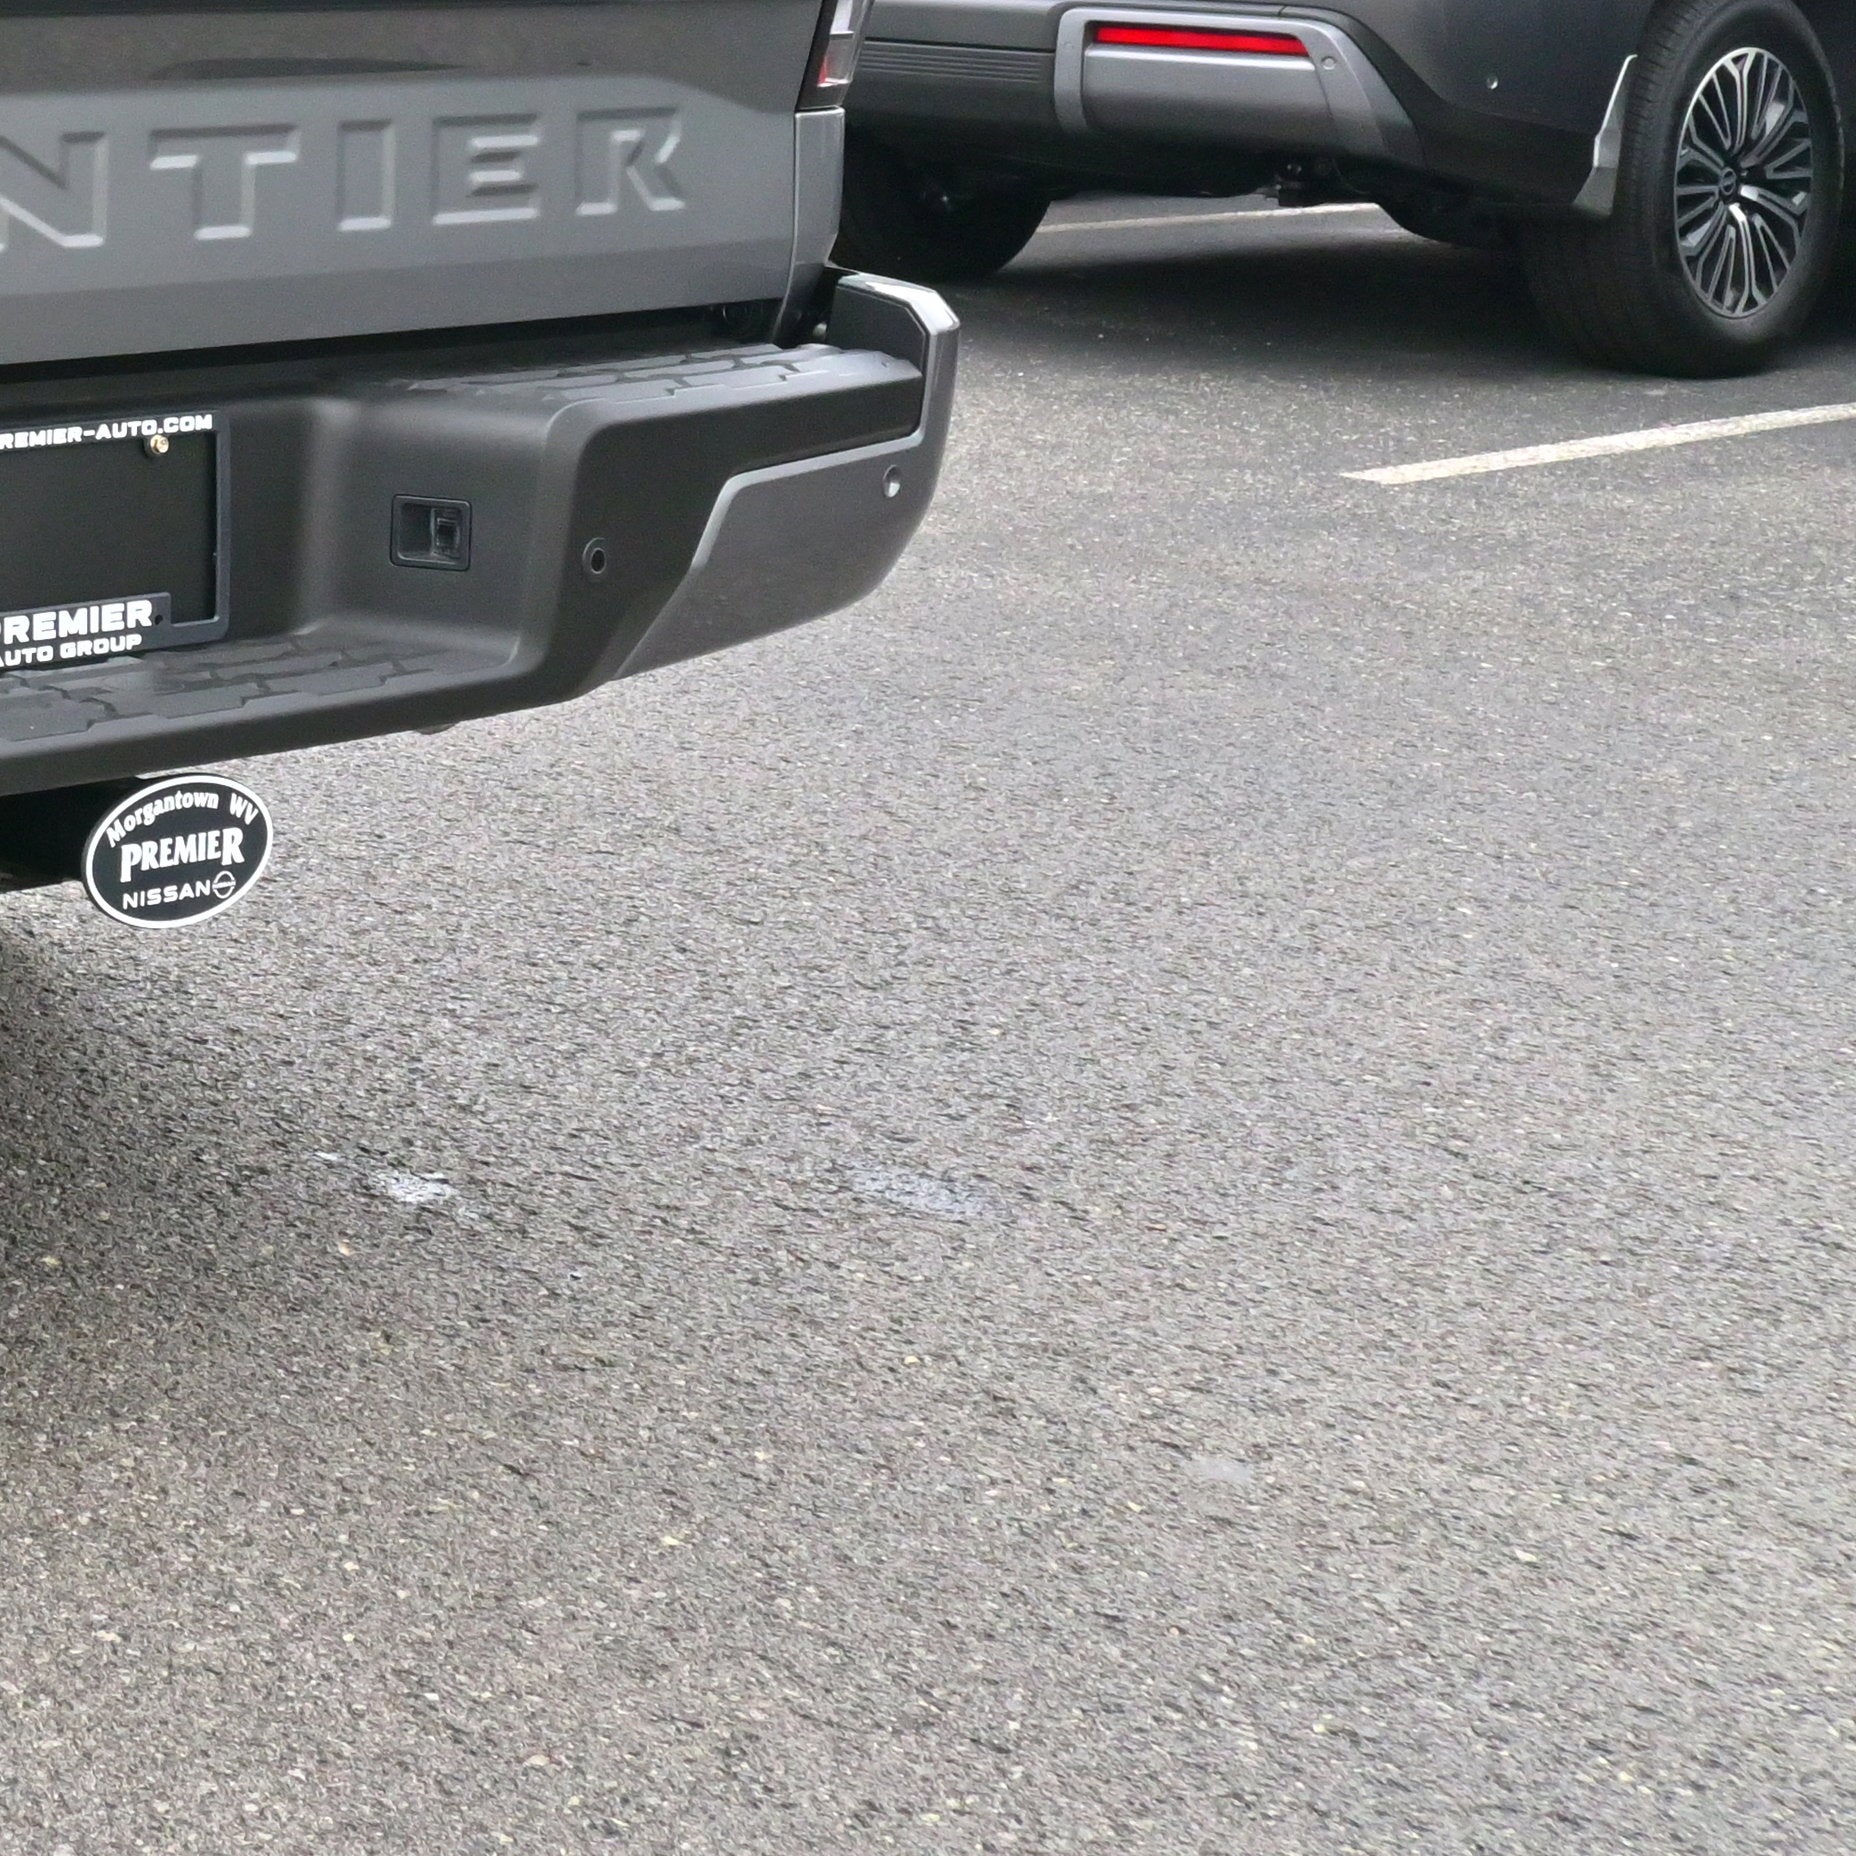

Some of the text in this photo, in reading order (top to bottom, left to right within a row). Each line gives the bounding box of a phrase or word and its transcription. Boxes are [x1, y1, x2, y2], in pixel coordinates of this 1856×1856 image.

[59, 633, 143, 660] GROUP
[105, 790, 260, 848] Morgantown WV
[120, 827, 245, 883] PREMIER
[122, 879, 212, 910] NISSAN
